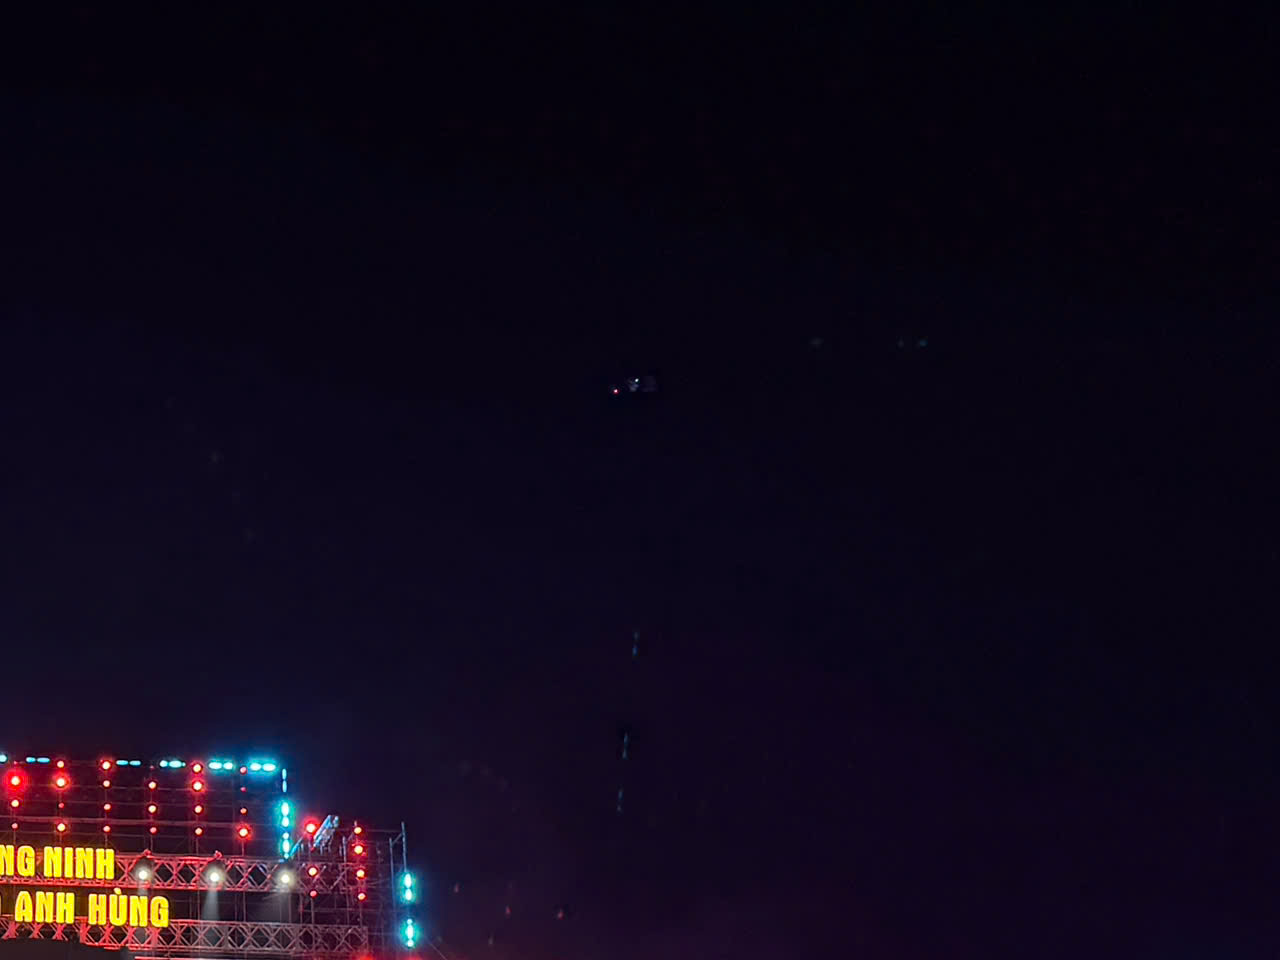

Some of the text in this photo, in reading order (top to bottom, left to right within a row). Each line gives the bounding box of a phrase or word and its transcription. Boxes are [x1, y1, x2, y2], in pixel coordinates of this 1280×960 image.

[43, 846, 115, 879] NINH
[15, 891, 75, 924] ANH
[88, 888, 169, 928] HÙNG
